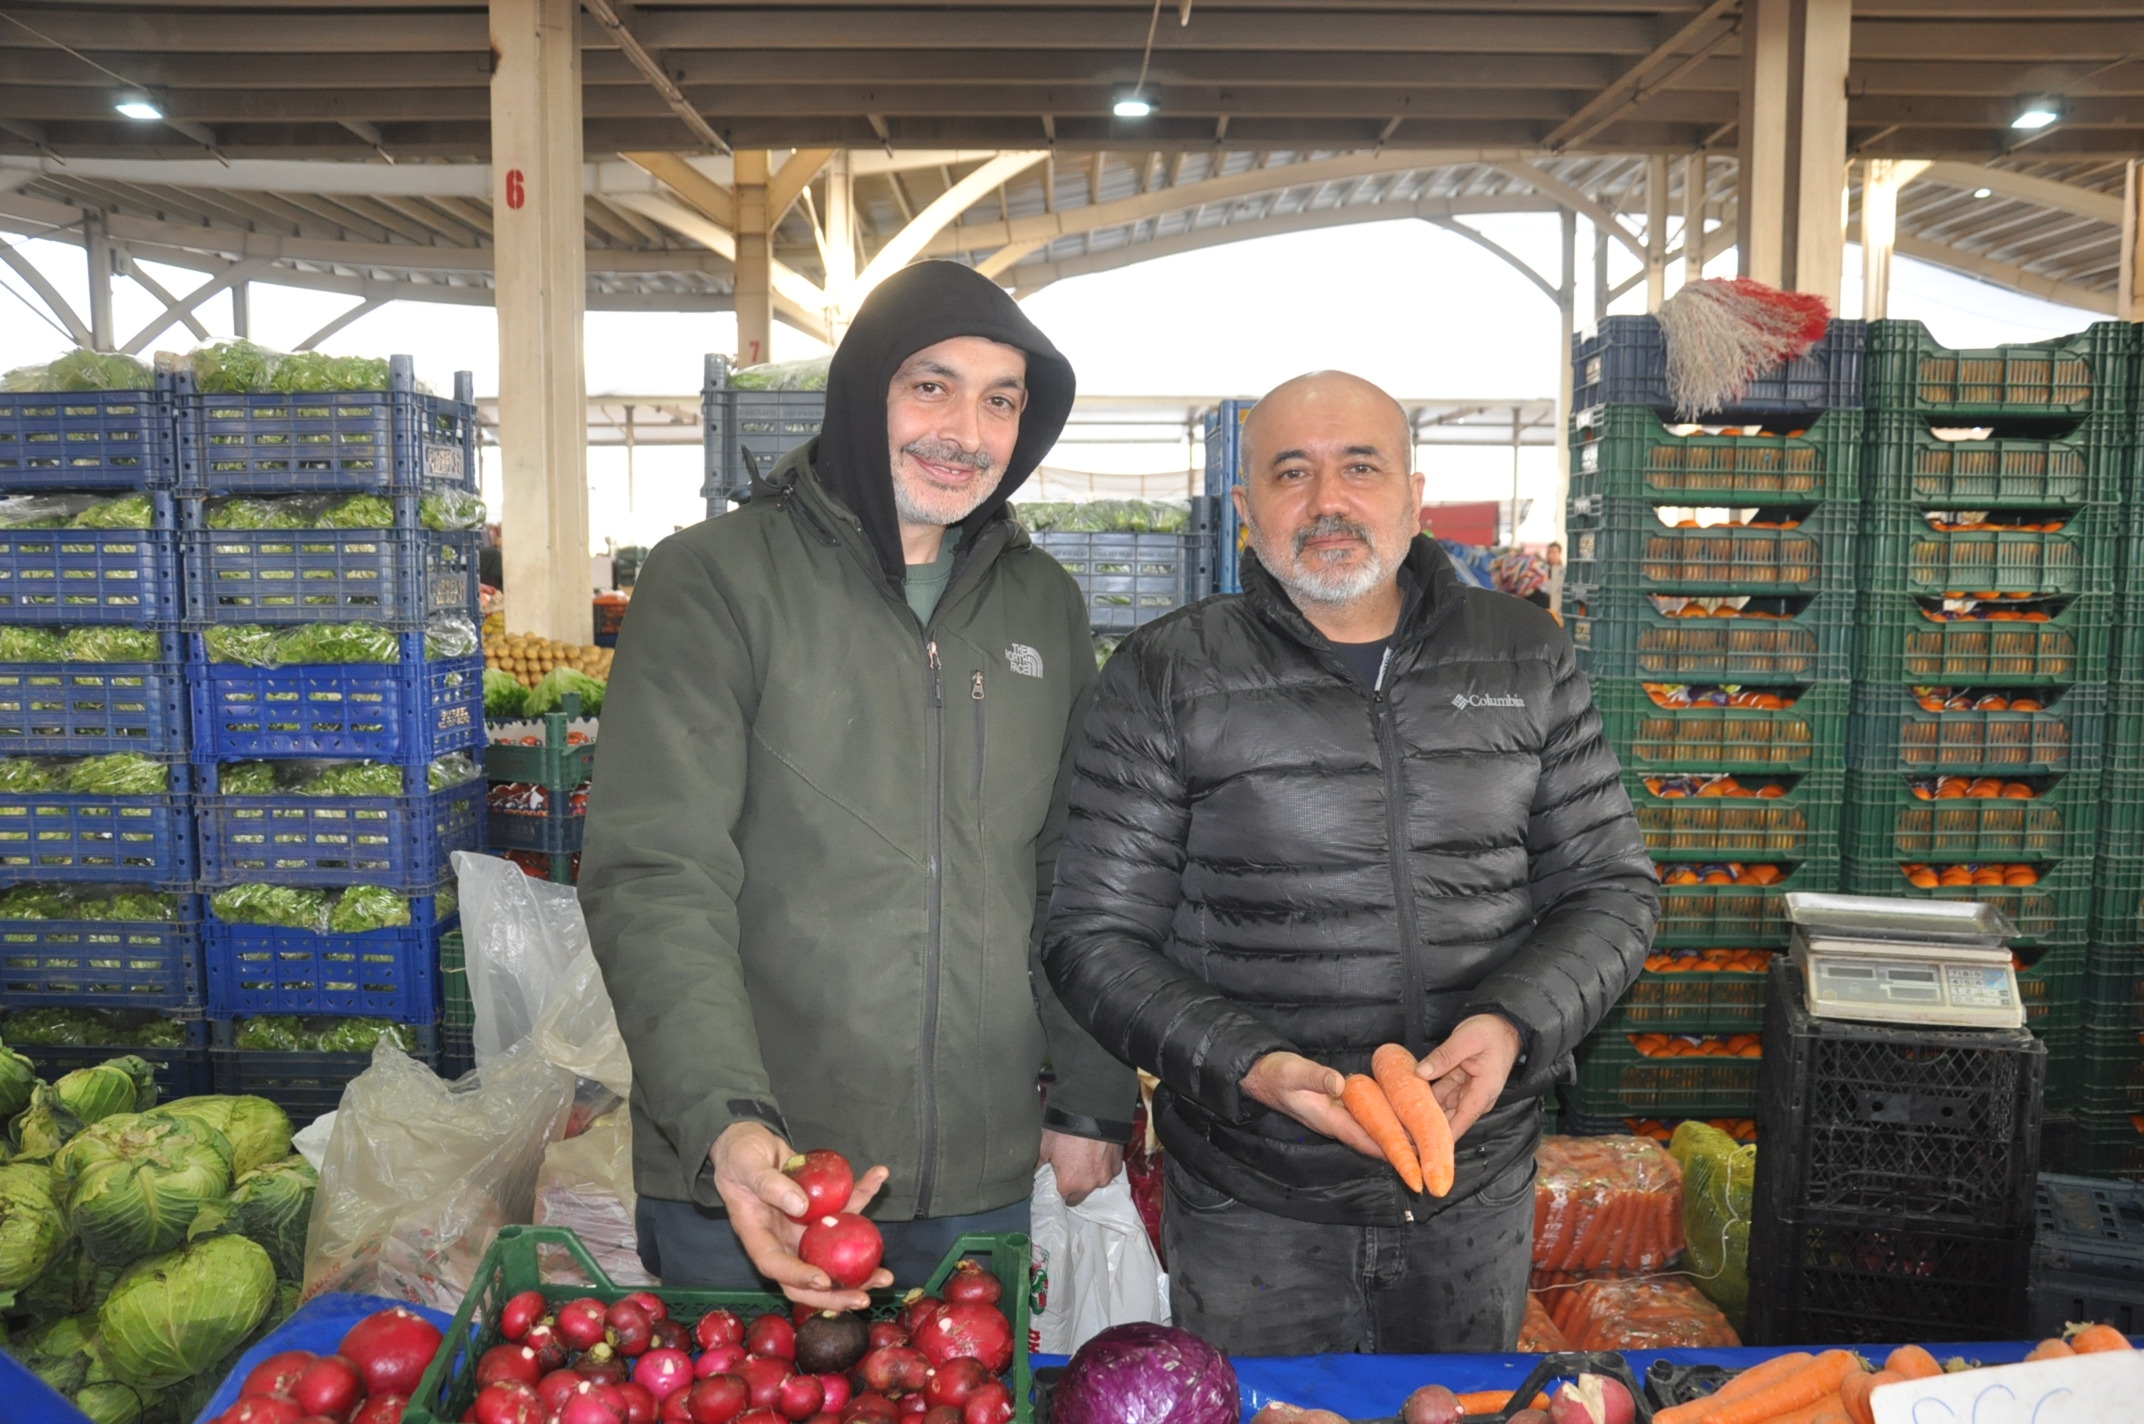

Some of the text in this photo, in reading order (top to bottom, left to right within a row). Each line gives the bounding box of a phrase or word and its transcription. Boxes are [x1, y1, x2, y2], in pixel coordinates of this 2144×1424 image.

[506, 169, 525, 210] 6
[749, 341, 761, 363] 7
[1011, 643, 1028, 656] THE
[1010, 661, 1031, 677] FACE
[1468, 693, 1525, 708] Columbia
